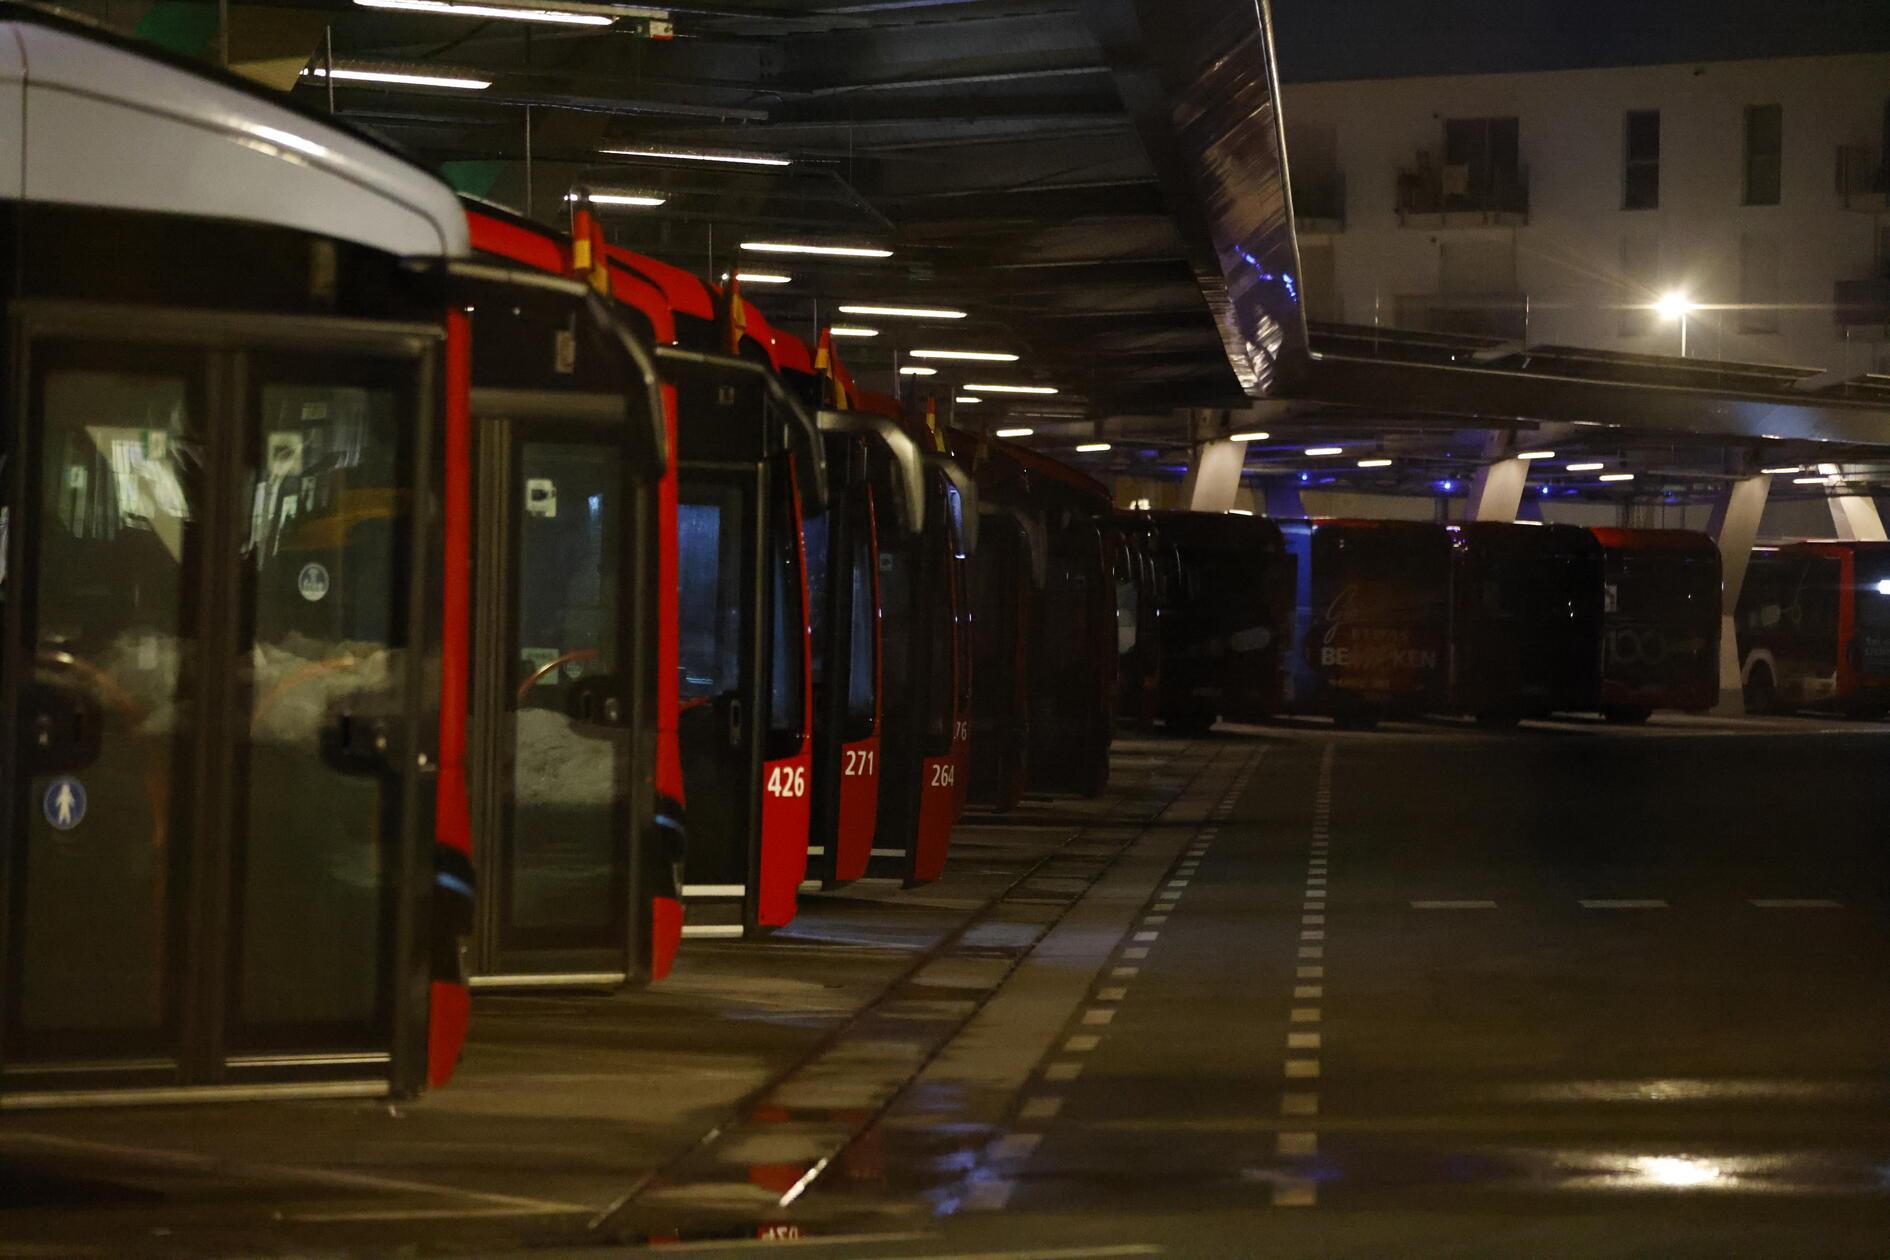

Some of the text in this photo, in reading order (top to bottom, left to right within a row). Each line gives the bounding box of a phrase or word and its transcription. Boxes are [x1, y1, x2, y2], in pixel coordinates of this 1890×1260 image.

[845, 750, 874, 776] 271
[931, 764, 954, 787] 264
[767, 766, 805, 798] 426
